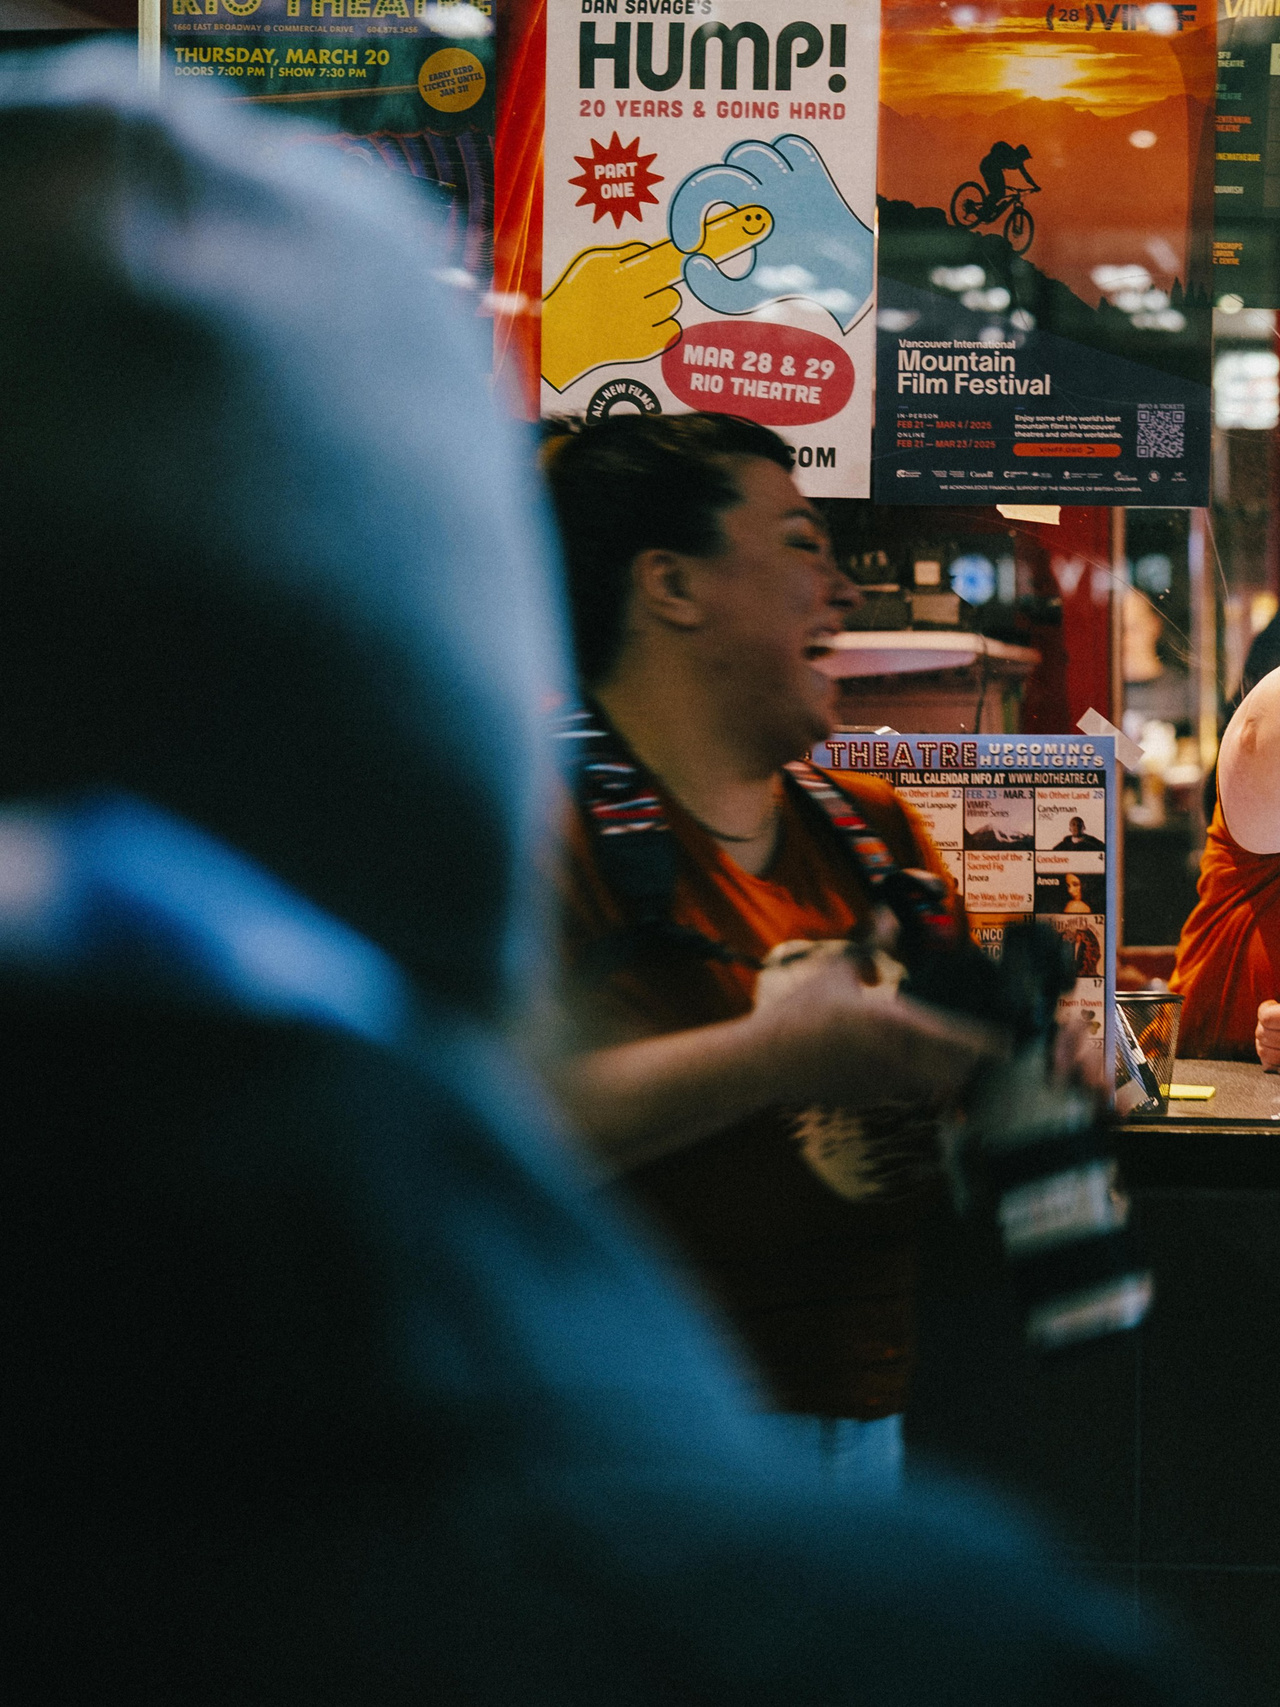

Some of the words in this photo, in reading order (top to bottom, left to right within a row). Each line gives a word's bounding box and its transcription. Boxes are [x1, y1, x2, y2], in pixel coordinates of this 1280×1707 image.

[581, 0, 618, 14] DAN
[624, 0, 712, 15] SAVAGE'S
[214, 24, 261, 32] BROADWAY
[273, 25, 327, 33] COMMERCIAL
[174, 47, 279, 66] THURSDAY,
[285, 48, 357, 65] MARCH
[364, 49, 390, 66] 20
[579, 20, 847, 93] HUMP!
[174, 66, 214, 76] DOORS
[217, 66, 243, 76] 7:00
[247, 67, 265, 76] PM
[278, 67, 316, 77] SHOW
[319, 68, 345, 78] 7:30
[348, 68, 367, 78] PM
[429, 70, 451, 82] EARLY
[453, 65, 474, 75] BIRD
[423, 78, 456, 92] TICKETS
[457, 72, 483, 84] UNTIL
[440, 88, 456, 97] JAN
[579, 100, 606, 117] 20
[616, 100, 684, 118] YEARS
[693, 101, 706, 119] &
[717, 101, 780, 119] GOING
[789, 102, 846, 121] HARD
[594, 162, 638, 180] PART
[600, 182, 635, 199] ONE
[898, 339, 952, 349] Vancouver
[953, 339, 1016, 350] International
[683, 344, 735, 370] MAR
[741, 351, 772, 374] 28
[780, 356, 796, 376] &
[804, 358, 836, 381] 29
[898, 350, 1016, 372] Mountain
[690, 373, 724, 393] RIO
[730, 377, 822, 405] THEATRE
[897, 372, 948, 394] Film
[954, 373, 1051, 396] Festival
[591, 399, 605, 418] ALL
[602, 384, 626, 400] NEW
[628, 384, 656, 411] FILMS
[897, 420, 913, 429] FEB
[914, 420, 924, 429] 21
[935, 421, 956, 429] MAR
[970, 421, 993, 430] 2025
[897, 440, 913, 448] FEB
[914, 440, 924, 448] 21
[935, 440, 956, 448] MAR
[974, 441, 996, 449] 2025
[825, 741, 978, 769] THEATRE
[988, 743, 1095, 756] UPCOMING
[979, 755, 1105, 767] HIGHLIGHTS
[900, 773, 922, 784] FULL
[924, 772, 970, 785] CALENDAR
[971, 773, 993, 784] INFO
[993, 773, 1006, 784] AT
[1007, 773, 1099, 785] WWW.RIOTHEATRE.CA
[966, 790, 985, 799] FEB.
[986, 790, 997, 799] 23
[1003, 790, 1028, 799] MAR.
[1037, 791, 1049, 799] No
[1049, 791, 1070, 799] Other
[1070, 791, 1090, 799] Land
[966, 809, 989, 817] Winter
[990, 810, 1010, 818] Series
[1037, 804, 1077, 814] Candyman
[967, 853, 980, 861] The
[982, 852, 1000, 861] Seed
[1001, 852, 1010, 861] of
[1011, 853, 1023, 861] the
[1026, 853, 1032, 861] 2
[1037, 856, 1069, 864] Conclave
[967, 863, 992, 871] Sacred
[993, 863, 1005, 872] Fig
[967, 874, 990, 882] Anora
[1036, 876, 1060, 886] Anora
[967, 893, 979, 901] The
[998, 893, 1010, 902] My
